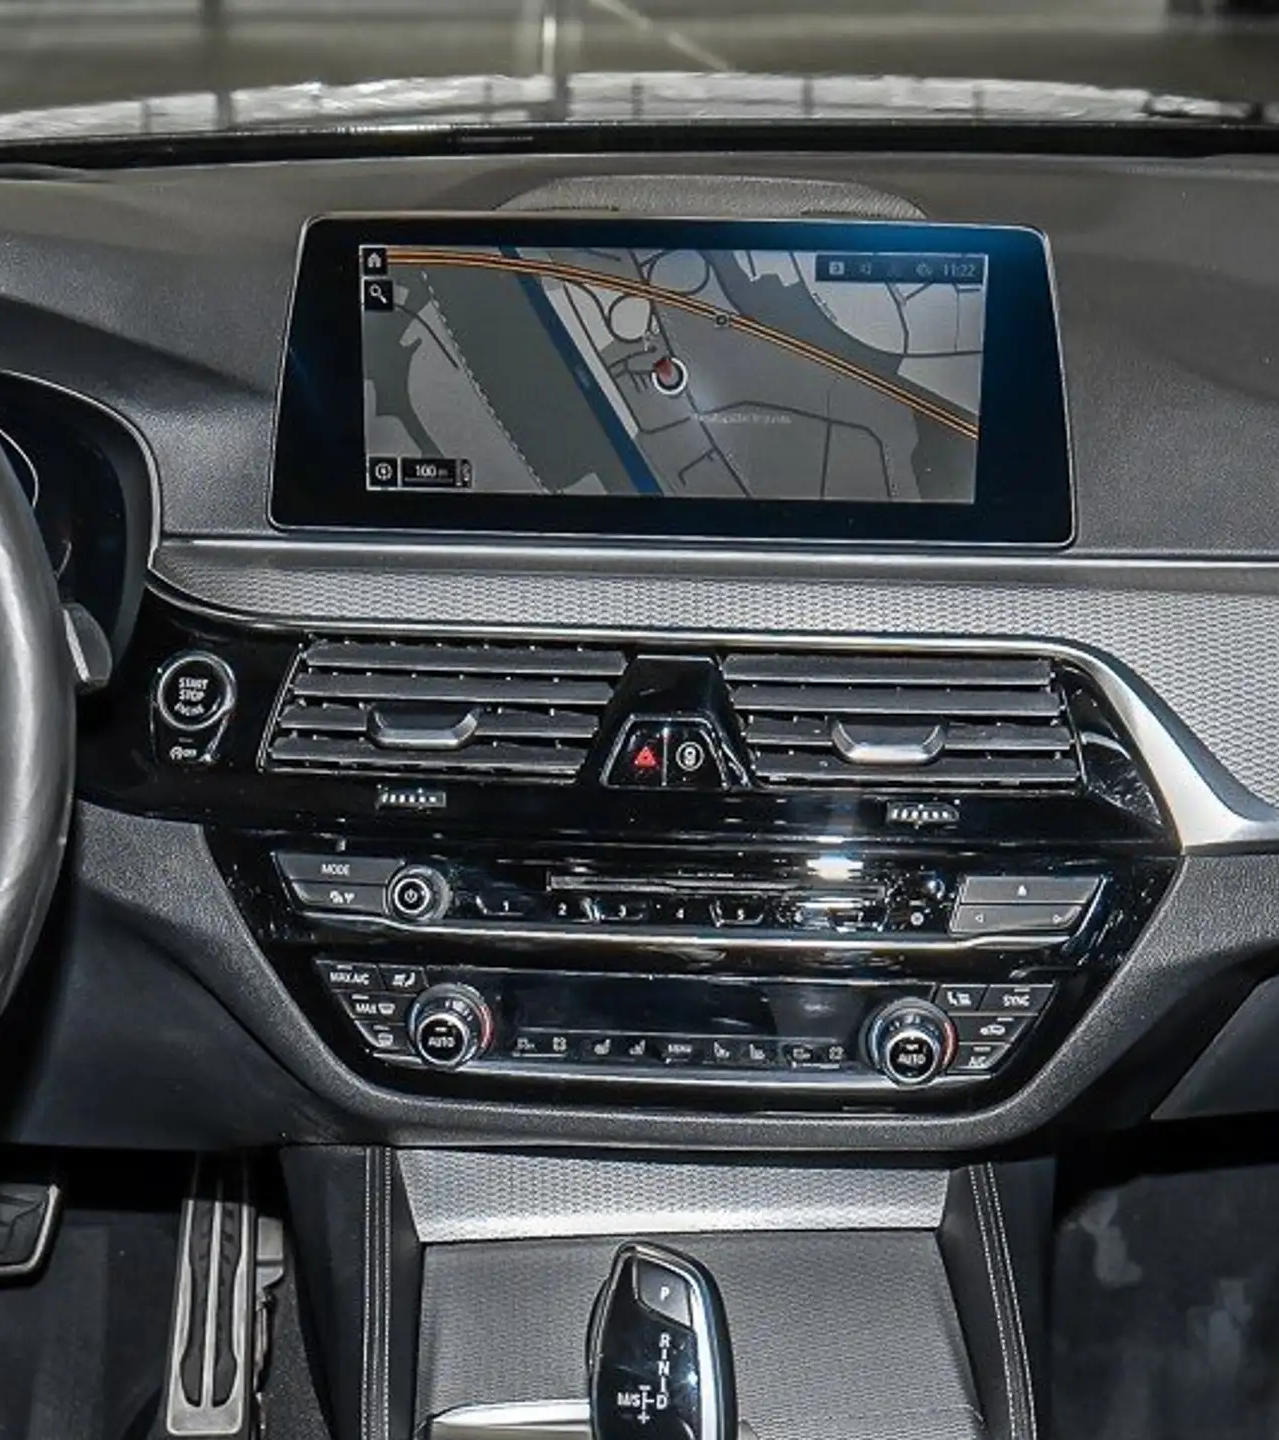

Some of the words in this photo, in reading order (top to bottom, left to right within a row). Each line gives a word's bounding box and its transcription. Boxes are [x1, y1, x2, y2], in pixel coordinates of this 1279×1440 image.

[415, 464, 438, 478] 100
[178, 677, 210, 691] START
[178, 688, 207, 702] STOP
[322, 863, 351, 877] MODE
[427, 1035, 456, 1049] AUTO
[897, 1052, 927, 1066] AUTO
[660, 1285, 671, 1301] P
[658, 1332, 671, 1348] R
[657, 1360, 671, 1377] N
[655, 1394, 669, 1410] D
